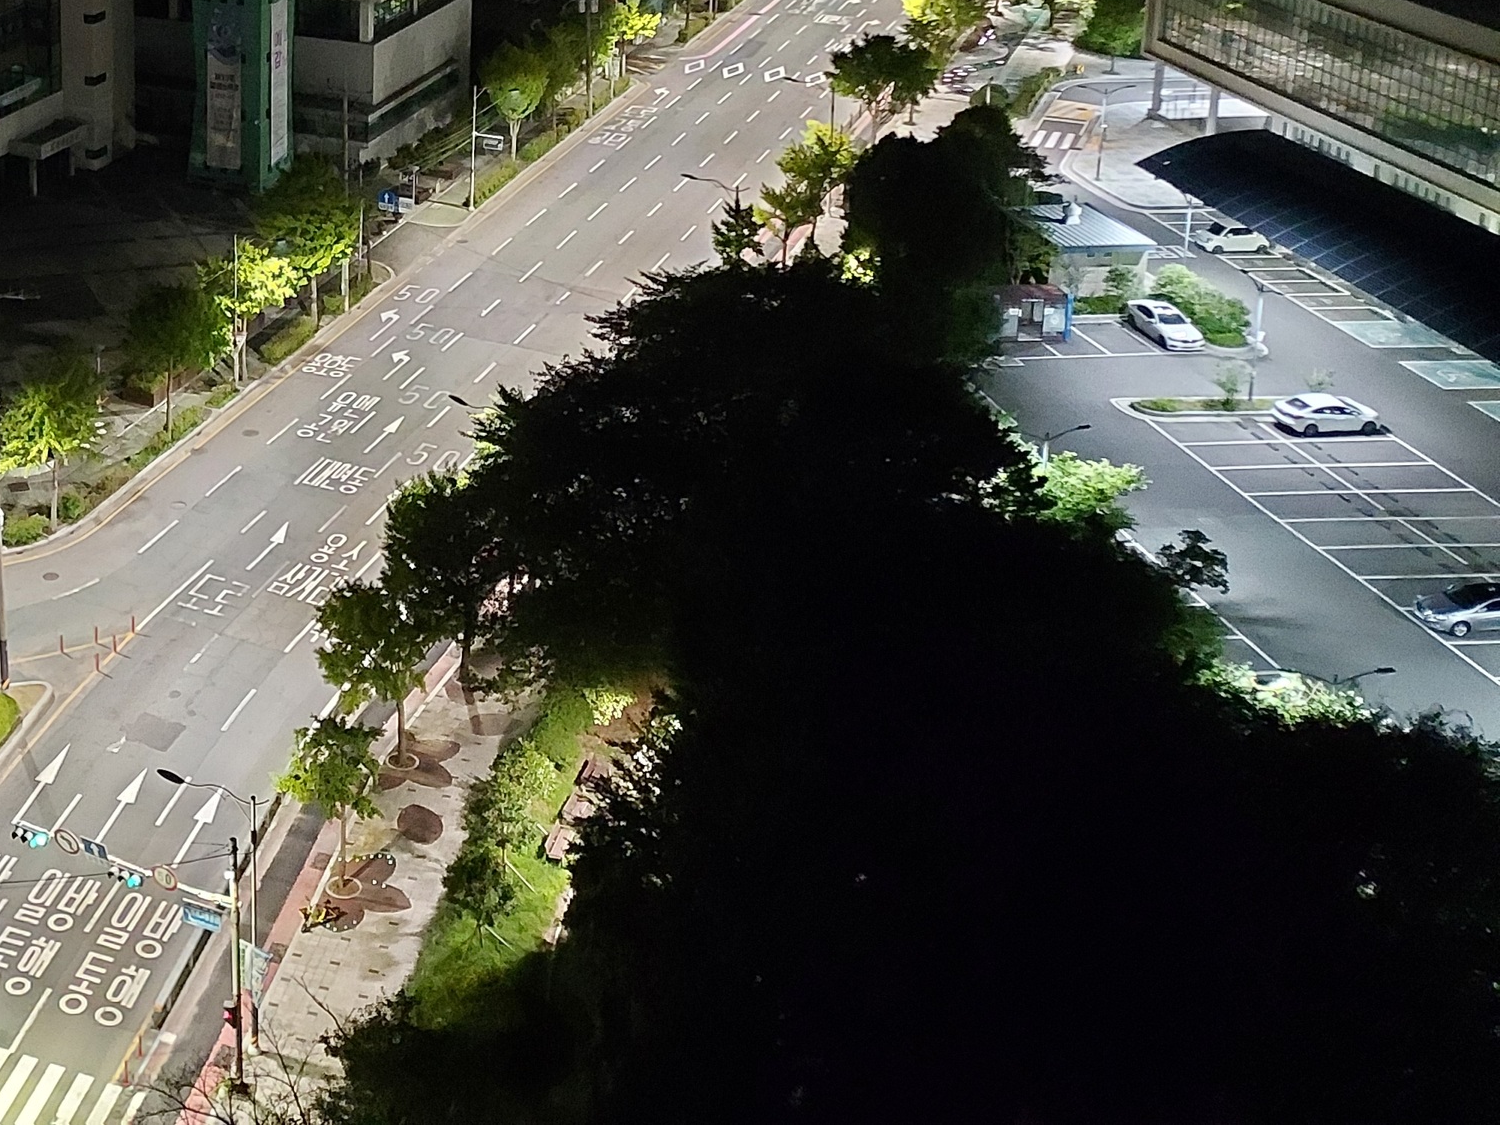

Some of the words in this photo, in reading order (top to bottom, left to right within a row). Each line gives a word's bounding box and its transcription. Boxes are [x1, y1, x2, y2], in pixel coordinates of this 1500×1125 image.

[393, 284, 441, 304] 50
[406, 323, 454, 347] 50
[301, 352, 362, 378] 용호동
[327, 391, 381, 419] 유엔
[398, 384, 449, 410] 50
[297, 413, 355, 443] 공원
[407, 442, 459, 472] 50
[302, 459, 376, 494] 대연동
[310, 533, 368, 572] 용소
[14, 868, 102, 933] 일방
[96, 892, 185, 960] 일방
[58, 950, 152, 1028] 통행
